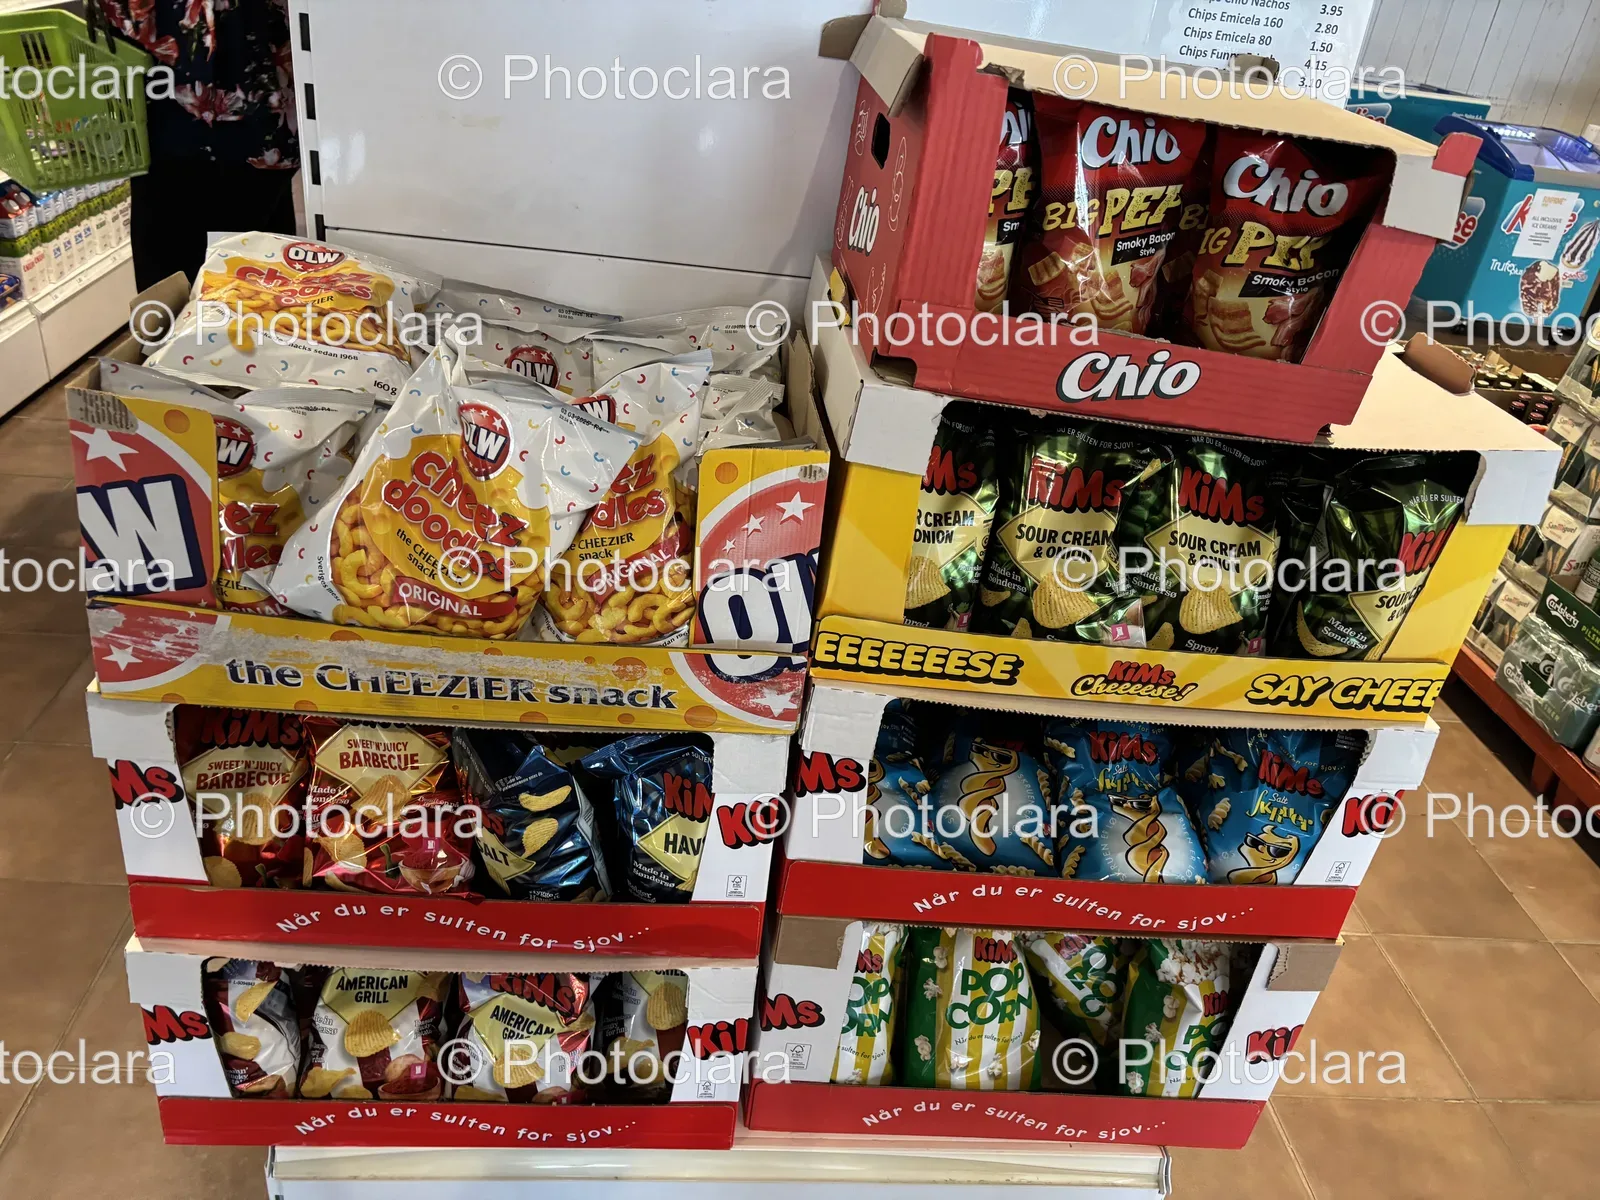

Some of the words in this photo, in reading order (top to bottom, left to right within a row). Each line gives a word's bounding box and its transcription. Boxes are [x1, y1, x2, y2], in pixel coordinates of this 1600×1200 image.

[1188, 7, 1217, 22] Chips
[1220, 12, 1260, 26] Emicela
[1263, 17, 1283, 28] 160
[1315, 23, 1338, 35] 2.80
[1251, 0, 1291, 10] Nachos
[1320, 4, 1343, 16] 3.95
[1179, 45, 1208, 59] Chips
[1184, 26, 1212, 40] Chips
[1215, 30, 1255, 45] Emicela
[1258, 35, 1272, 46] 80
[1309, 41, 1333, 53] 1.50
[1081, 115, 1181, 168] Chio
[1223, 154, 1348, 217] Chio
[848, 184, 881, 257] Chio
[288, 246, 341, 265] OLW
[1117, 237, 1147, 252] Smoky
[1139, 247, 1156, 257] Style
[1251, 274, 1294, 288] Smoky
[1297, 268, 1340, 286] Bacon
[1285, 285, 1308, 294] Style
[313, 348, 339, 358] sedan
[339, 353, 359, 361] 1968
[373, 379, 390, 393] 160
[1058, 350, 1201, 402] Chio
[1076, 431, 1098, 447] SULTEN
[1099, 439, 1113, 449] FOR
[921, 444, 978, 495] Ms
[1028, 456, 1126, 512] KiMs
[1178, 466, 1265, 526] KiMs
[1429, 493, 1439, 502] ER
[1440, 493, 1465, 503] SULTEN
[924, 509, 975, 527] CREAM
[396, 528, 412, 547] the
[578, 532, 635, 550] CHEEZIER
[1015, 523, 1059, 544] SOUR
[1061, 530, 1114, 547] CREAM
[1168, 529, 1207, 552] SOUR
[1209, 539, 1262, 557] CREAM
[578, 548, 613, 562] snack
[1033, 546, 1043, 558] &
[1187, 551, 1197, 565] &
[407, 552, 439, 581] snack
[592, 547, 672, 596] ORIGINAL
[990, 560, 1010, 581] Made
[1010, 570, 1022, 583] in
[987, 572, 1028, 594] Søndersø
[1131, 576, 1178, 599] Søndersø
[398, 582, 483, 617] ORIGINAL
[1545, 593, 1580, 629] Carlsberg
[700, 553, 819, 683] OL
[1327, 616, 1357, 637] Made
[1355, 631, 1368, 643] in
[1321, 626, 1369, 650] Søndersø
[813, 631, 1023, 686] EEEEEEESE
[225, 657, 303, 688] the
[313, 663, 540, 705] CHEEZIER
[547, 684, 680, 711] snack
[1107, 660, 1177, 686] KiMs
[1071, 673, 1198, 702] Cheeeese!
[1247, 674, 1328, 705] SAY
[202, 708, 302, 749] KiMs
[339, 750, 420, 771] BARBECUE
[1089, 731, 1158, 764] KiMs
[106, 759, 184, 809] Ms
[196, 770, 293, 791] BARBECUE
[796, 751, 866, 797] Ms
[1114, 764, 1129, 776] Salt
[663, 772, 716, 822] KiM
[1268, 792, 1289, 805] Salt
[632, 859, 659, 876] Made
[659, 871, 669, 881] in
[912, 889, 960, 914] Når
[972, 883, 1003, 898] du
[1015, 886, 1043, 898] er
[1053, 892, 1122, 921] sulten
[1129, 913, 1165, 929] for
[1177, 907, 1254, 931] sjov...
[276, 908, 321, 935] Når
[334, 902, 367, 919] du
[379, 904, 410, 917] er
[424, 911, 507, 941] sulten
[519, 932, 558, 949] for
[573, 926, 650, 952] sjov...
[856, 949, 884, 974] Ms
[974, 935, 1018, 964] KiM
[335, 975, 408, 991] AMERICAN
[848, 975, 890, 1008] OP
[960, 961, 1025, 998] POP
[354, 991, 389, 1004] GRILL
[490, 972, 576, 1017] KiMs
[946, 986, 1033, 1030] CORN
[141, 1004, 212, 1045] Ms
[489, 1004, 556, 1037] AMERICAN
[761, 993, 826, 1031] Ms
[1183, 1016, 1231, 1045] PO
[841, 1045, 860, 1057] sulten
[860, 1051, 871, 1059] for
[295, 1112, 337, 1135] Når
[347, 1106, 378, 1120] du
[390, 1107, 417, 1117] er
[430, 1110, 506, 1136] sulten
[517, 1127, 552, 1141] for
[567, 1121, 636, 1144] sjov...
[861, 1109, 903, 1128] Når
[913, 1101, 941, 1113] du
[951, 1102, 976, 1112] er
[984, 1105, 1048, 1131] sulten
[1055, 1124, 1087, 1138] for
[1098, 1120, 1166, 1141] sjov...
